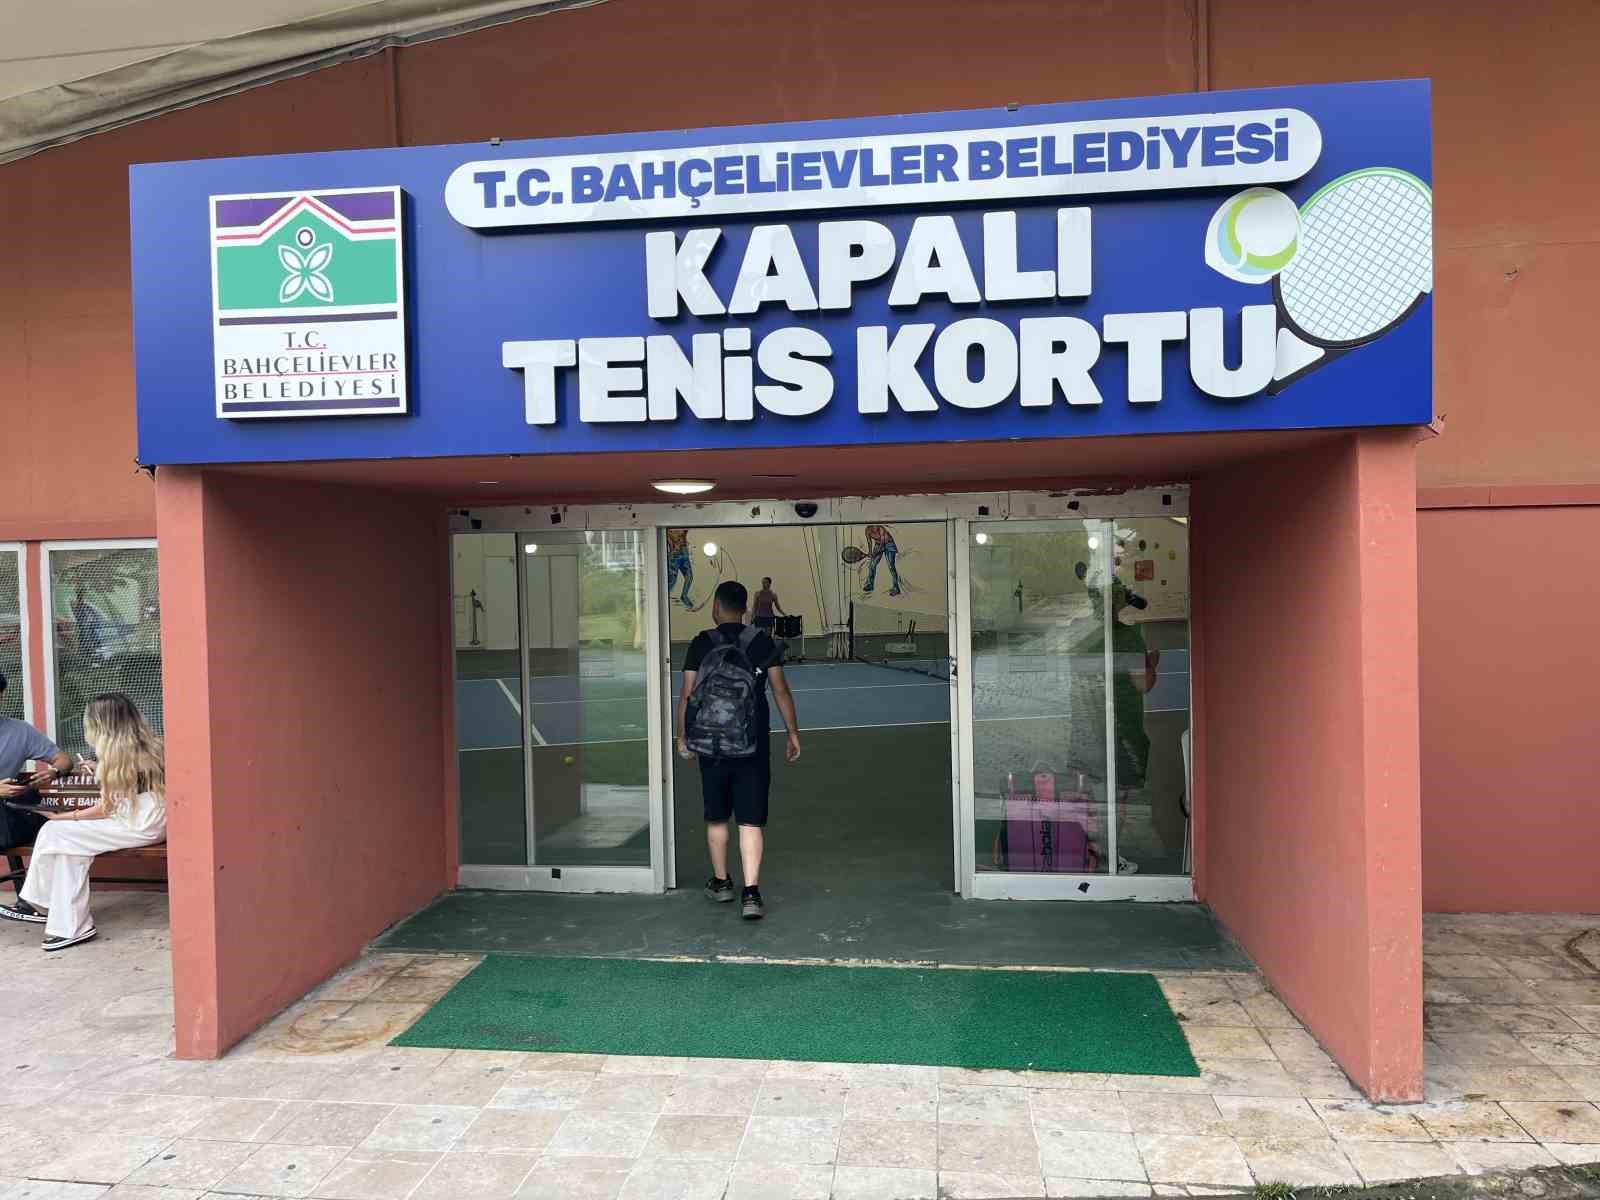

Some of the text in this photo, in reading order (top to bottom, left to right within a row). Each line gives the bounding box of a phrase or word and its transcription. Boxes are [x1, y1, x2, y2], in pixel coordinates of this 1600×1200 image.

[474, 168, 563, 208] T.C.
[645, 206, 1092, 319] KAPALI
[283, 330, 327, 348] T.C.
[223, 351, 397, 376] BAHÇELİEVLER
[856, 303, 1277, 415] KORTU
[224, 374, 396, 399] BELEDİYESİ
[62, 797, 75, 807] VE
[78, 797, 99, 807] BAH
